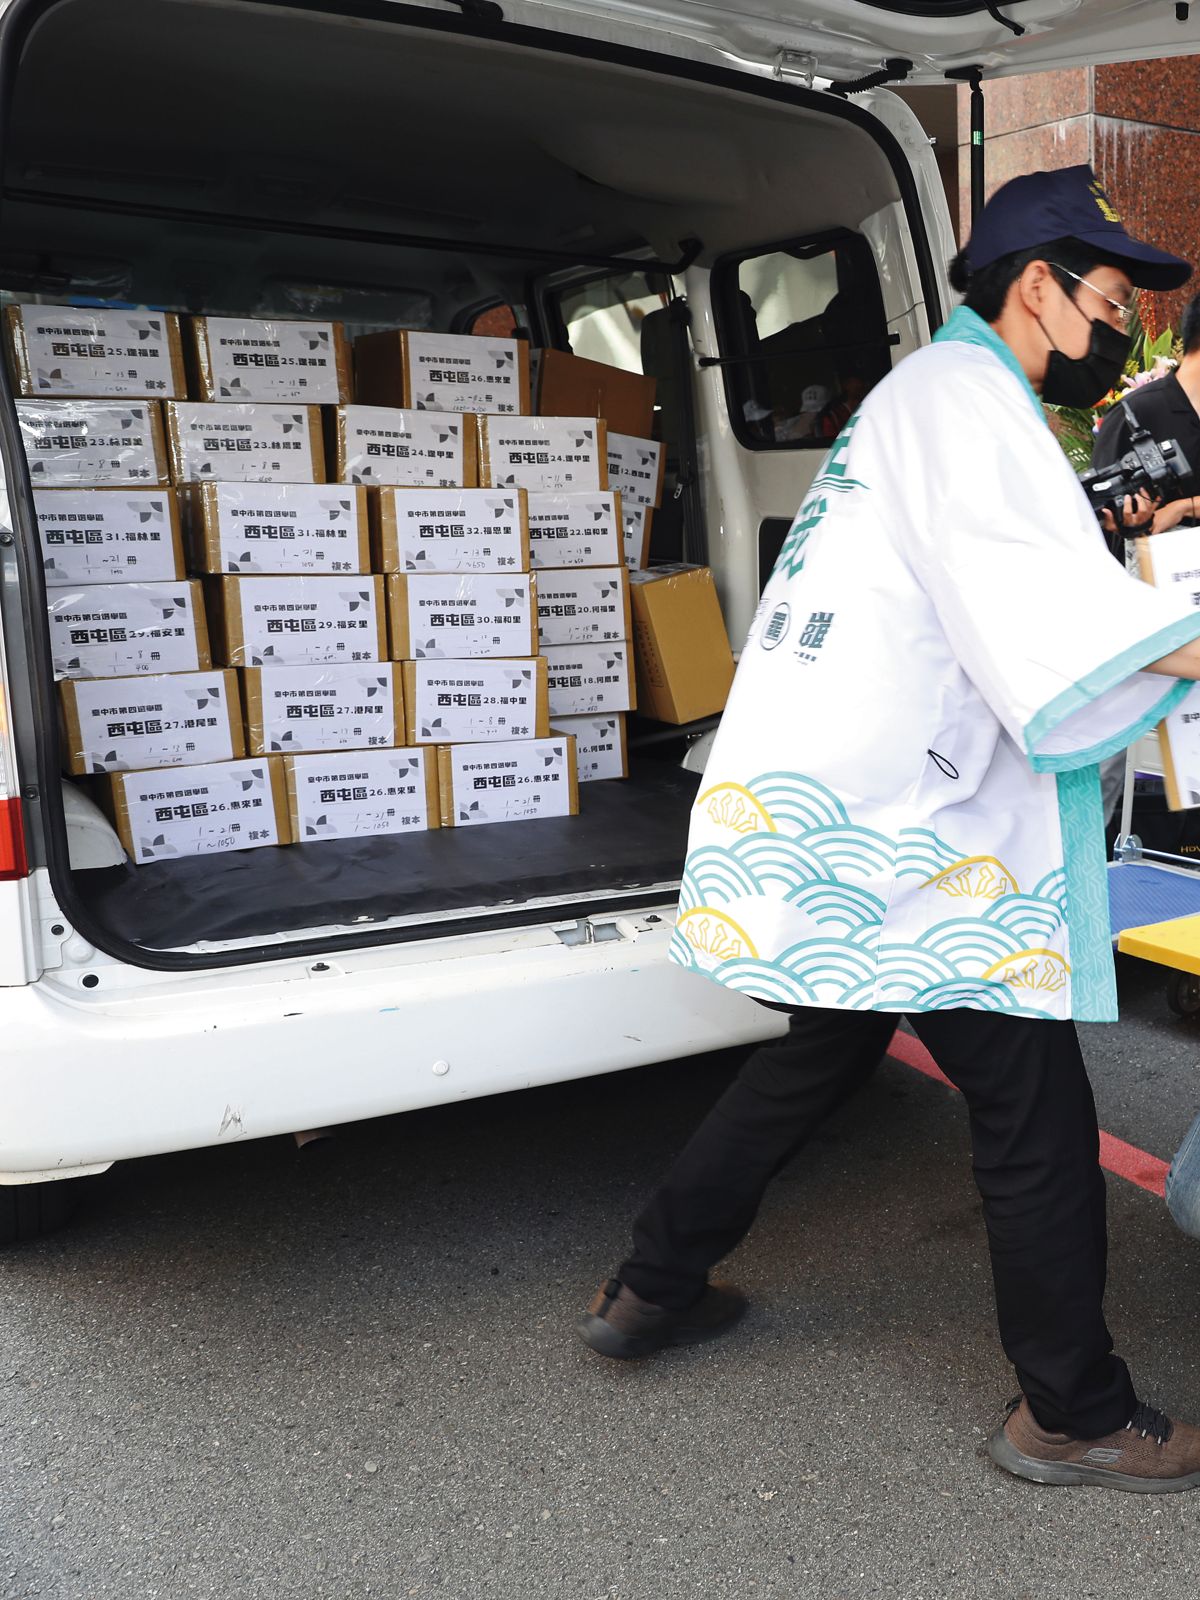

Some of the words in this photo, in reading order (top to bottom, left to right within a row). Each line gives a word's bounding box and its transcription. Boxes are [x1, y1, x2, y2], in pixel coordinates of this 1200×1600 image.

[145, 380, 166, 389] 複本
[498, 404, 514, 412] 複本
[128, 469, 149, 478] 複本
[332, 561, 352, 571] 複本
[498, 557, 515, 566] 複本
[54, 613, 127, 622] 臺中市第四選舉區
[352, 651, 371, 660] 複本
[275, 690, 336, 698] 臺中市第四選舉區
[92, 704, 163, 716] 臺中市第四選舉區
[511, 726, 529, 735] 複本
[368, 736, 387, 745] 複本
[463, 761, 517, 771] 臺中市第四選舉區
[308, 773, 369, 783] 臺中市第四選舉區
[140, 787, 208, 801] 臺中市第四選舉區
[401, 815, 420, 825] 複本
[248, 830, 269, 840] 複本
